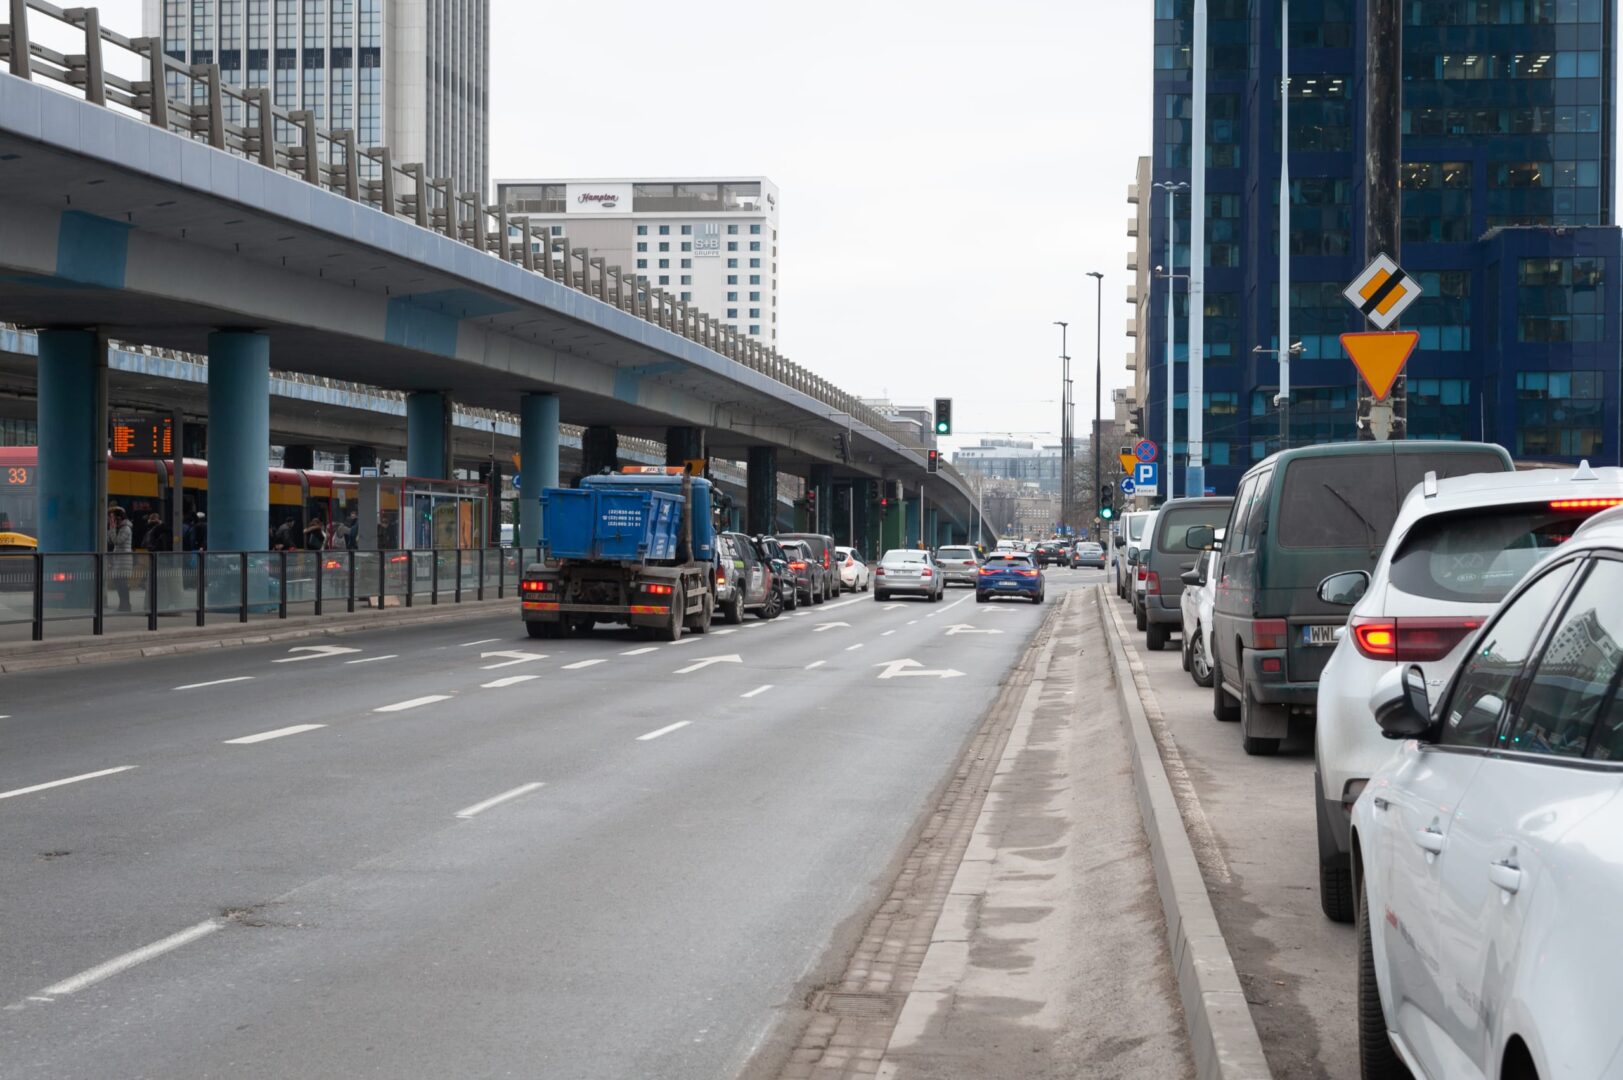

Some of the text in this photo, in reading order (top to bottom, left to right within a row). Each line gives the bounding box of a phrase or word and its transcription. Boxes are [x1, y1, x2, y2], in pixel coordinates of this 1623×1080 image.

[578, 193, 619, 203] Hampton
[8, 468, 27, 484] 33
[1140, 465, 1153, 483] P
[1311, 627, 1340, 642] WWL
